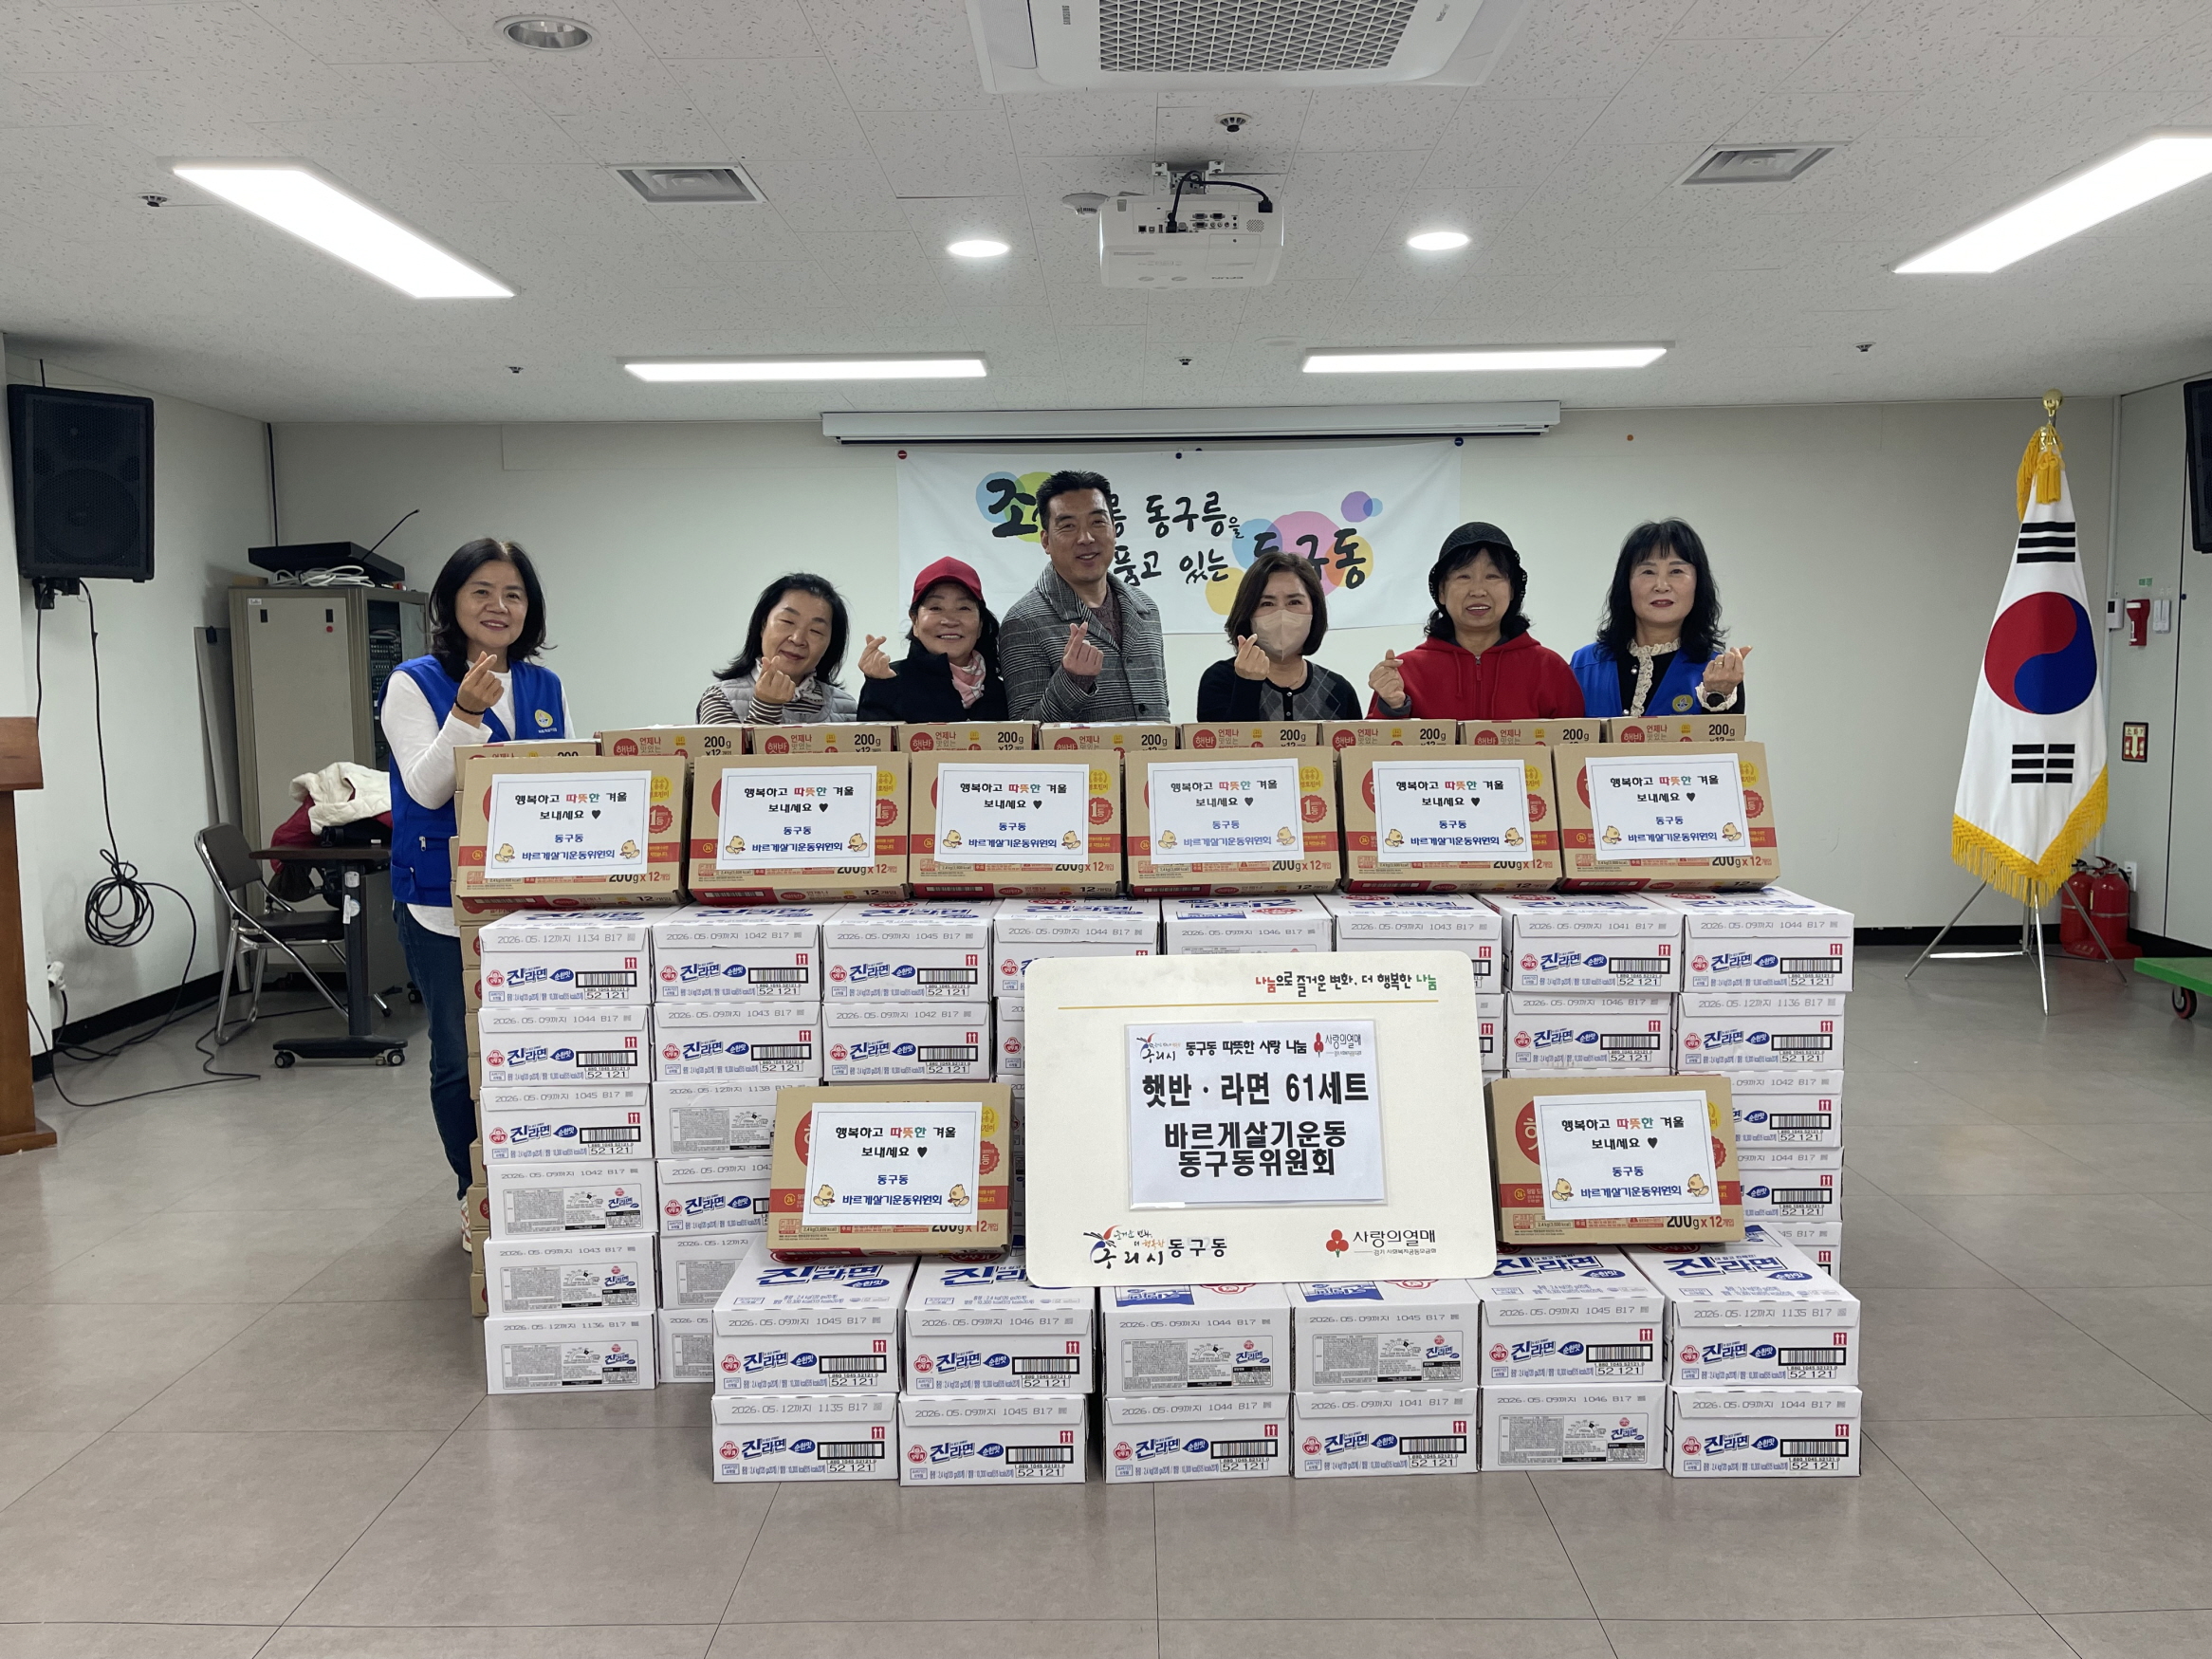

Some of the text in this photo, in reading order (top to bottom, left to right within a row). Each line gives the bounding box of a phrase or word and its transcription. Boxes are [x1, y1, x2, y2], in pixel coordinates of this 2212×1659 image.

[1062, 5, 1071, 25] SAMSUNG
[1146, 491, 1244, 540] 동구릉을
[1180, 549, 1229, 583] 있는
[1356, 728, 1378, 738] 언제나
[1419, 728, 1447, 742] 200g
[1500, 728, 1521, 738] 언제나
[1562, 728, 1590, 741] 200g
[1647, 725, 1668, 734] 언제나
[1708, 724, 1735, 738] 200g
[791, 734, 812, 743] 언제나
[855, 734, 881, 747] 200g
[997, 731, 1023, 746] 200g
[1079, 735, 1100, 744] 언제나
[1141, 733, 1168, 747] 200g
[1281, 729, 1306, 743] 200g
[704, 736, 732, 749] 200g
[1171, 780, 1277, 792] 행복하고 따뜻한 겨울
[1396, 781, 1503, 791] 행복하고 따뜻한 겨울
[1611, 775, 1719, 787] 행복하고 따뜻한 겨울
[745, 786, 854, 798] 행복하고 따뜻한 겨울
[961, 783, 1066, 793] 행복하고 따뜻한 겨울
[515, 792, 627, 804] 행복하고 따뜻한 겨울
[1196, 798, 1238, 807] 보내세요
[1423, 798, 1464, 806] 보내세요
[1637, 793, 1680, 802] 보내세요
[769, 803, 811, 813] 보내세요
[985, 800, 1025, 809] 보내세요
[540, 810, 583, 820] 보내세요
[1656, 817, 1683, 825] 동구동
[783, 826, 811, 835] 동구동
[999, 822, 1026, 831] 동구동
[1213, 820, 1239, 829] 동구동
[1439, 820, 1466, 829] 동구동
[555, 834, 583, 842] 동구동
[968, 839, 1057, 848] 바르게살기운동위원회
[1184, 837, 1271, 847] 바르게살기운동위원회
[1410, 837, 1499, 845] 바르게살기운동위원회
[1629, 833, 1717, 842] 바르게살기운동위원회
[752, 842, 842, 852] 바르게살기운동위원회
[523, 850, 615, 860] 바르게살기운동위원회
[1710, 954, 1778, 973] 진라면 순한맛
[507, 968, 573, 987] 진라면 순한맛
[1256, 971, 1292, 993] 나눔으로
[1297, 974, 1326, 997] 즐거운
[1330, 973, 1356, 989] 변화,
[1377, 973, 1411, 990] 행복한
[1416, 974, 1436, 990] 나눔
[1325, 1034, 1361, 1049] 사랑의열매
[1186, 1041, 1217, 1056] 동구동
[1223, 1041, 1254, 1055] 따뜻한
[1260, 1041, 1281, 1054] 사랑
[1286, 1041, 1306, 1054] 나눔
[1142, 1049, 1176, 1063] 구리시
[1142, 1074, 1191, 1108] 햇반
[1221, 1072, 1269, 1106] 라면
[1286, 1072, 1369, 1104] 61세트
[1561, 1116, 1684, 1132] 행복하고 따뜻한 겨울
[836, 1127, 956, 1138] 행복하고 따뜻한 겨울
[1165, 1120, 1346, 1149] 바르게살기운동
[1593, 1138, 1640, 1150] 보내세요
[862, 1147, 909, 1157] 보내세요
[1178, 1150, 1335, 1176] 동구동위원회
[1613, 1167, 1644, 1177] 동구동
[877, 1175, 908, 1185] 동구동
[1581, 1186, 1682, 1198] 바르게살기운동위원회
[842, 1195, 942, 1206] 바르게살기운동위원회
[1354, 1230, 1435, 1247] 사랑의열매
[1094, 1238, 1227, 1269] 구리시 동구동
[1496, 1256, 1620, 1279] 진라면 순한맛
[1664, 1255, 1787, 1278] 진라면
[756, 1264, 883, 1286] 진라면
[1511, 1341, 1581, 1362] 진라면 순한맛
[1702, 1344, 1774, 1364] 진라면 순한맛
[743, 1352, 814, 1373] 진라면 순한맛
[935, 1354, 1007, 1374] 진라면 순한맛
[742, 1439, 813, 1459] 진라면 순한맛
[1135, 1437, 1207, 1461] 진라면 순한맛
[1324, 1434, 1395, 1455] 진라면 순한맛
[1704, 1435, 1777, 1456] 진라면 순한맛
[930, 1443, 1002, 1465] 진라면 순한맛
